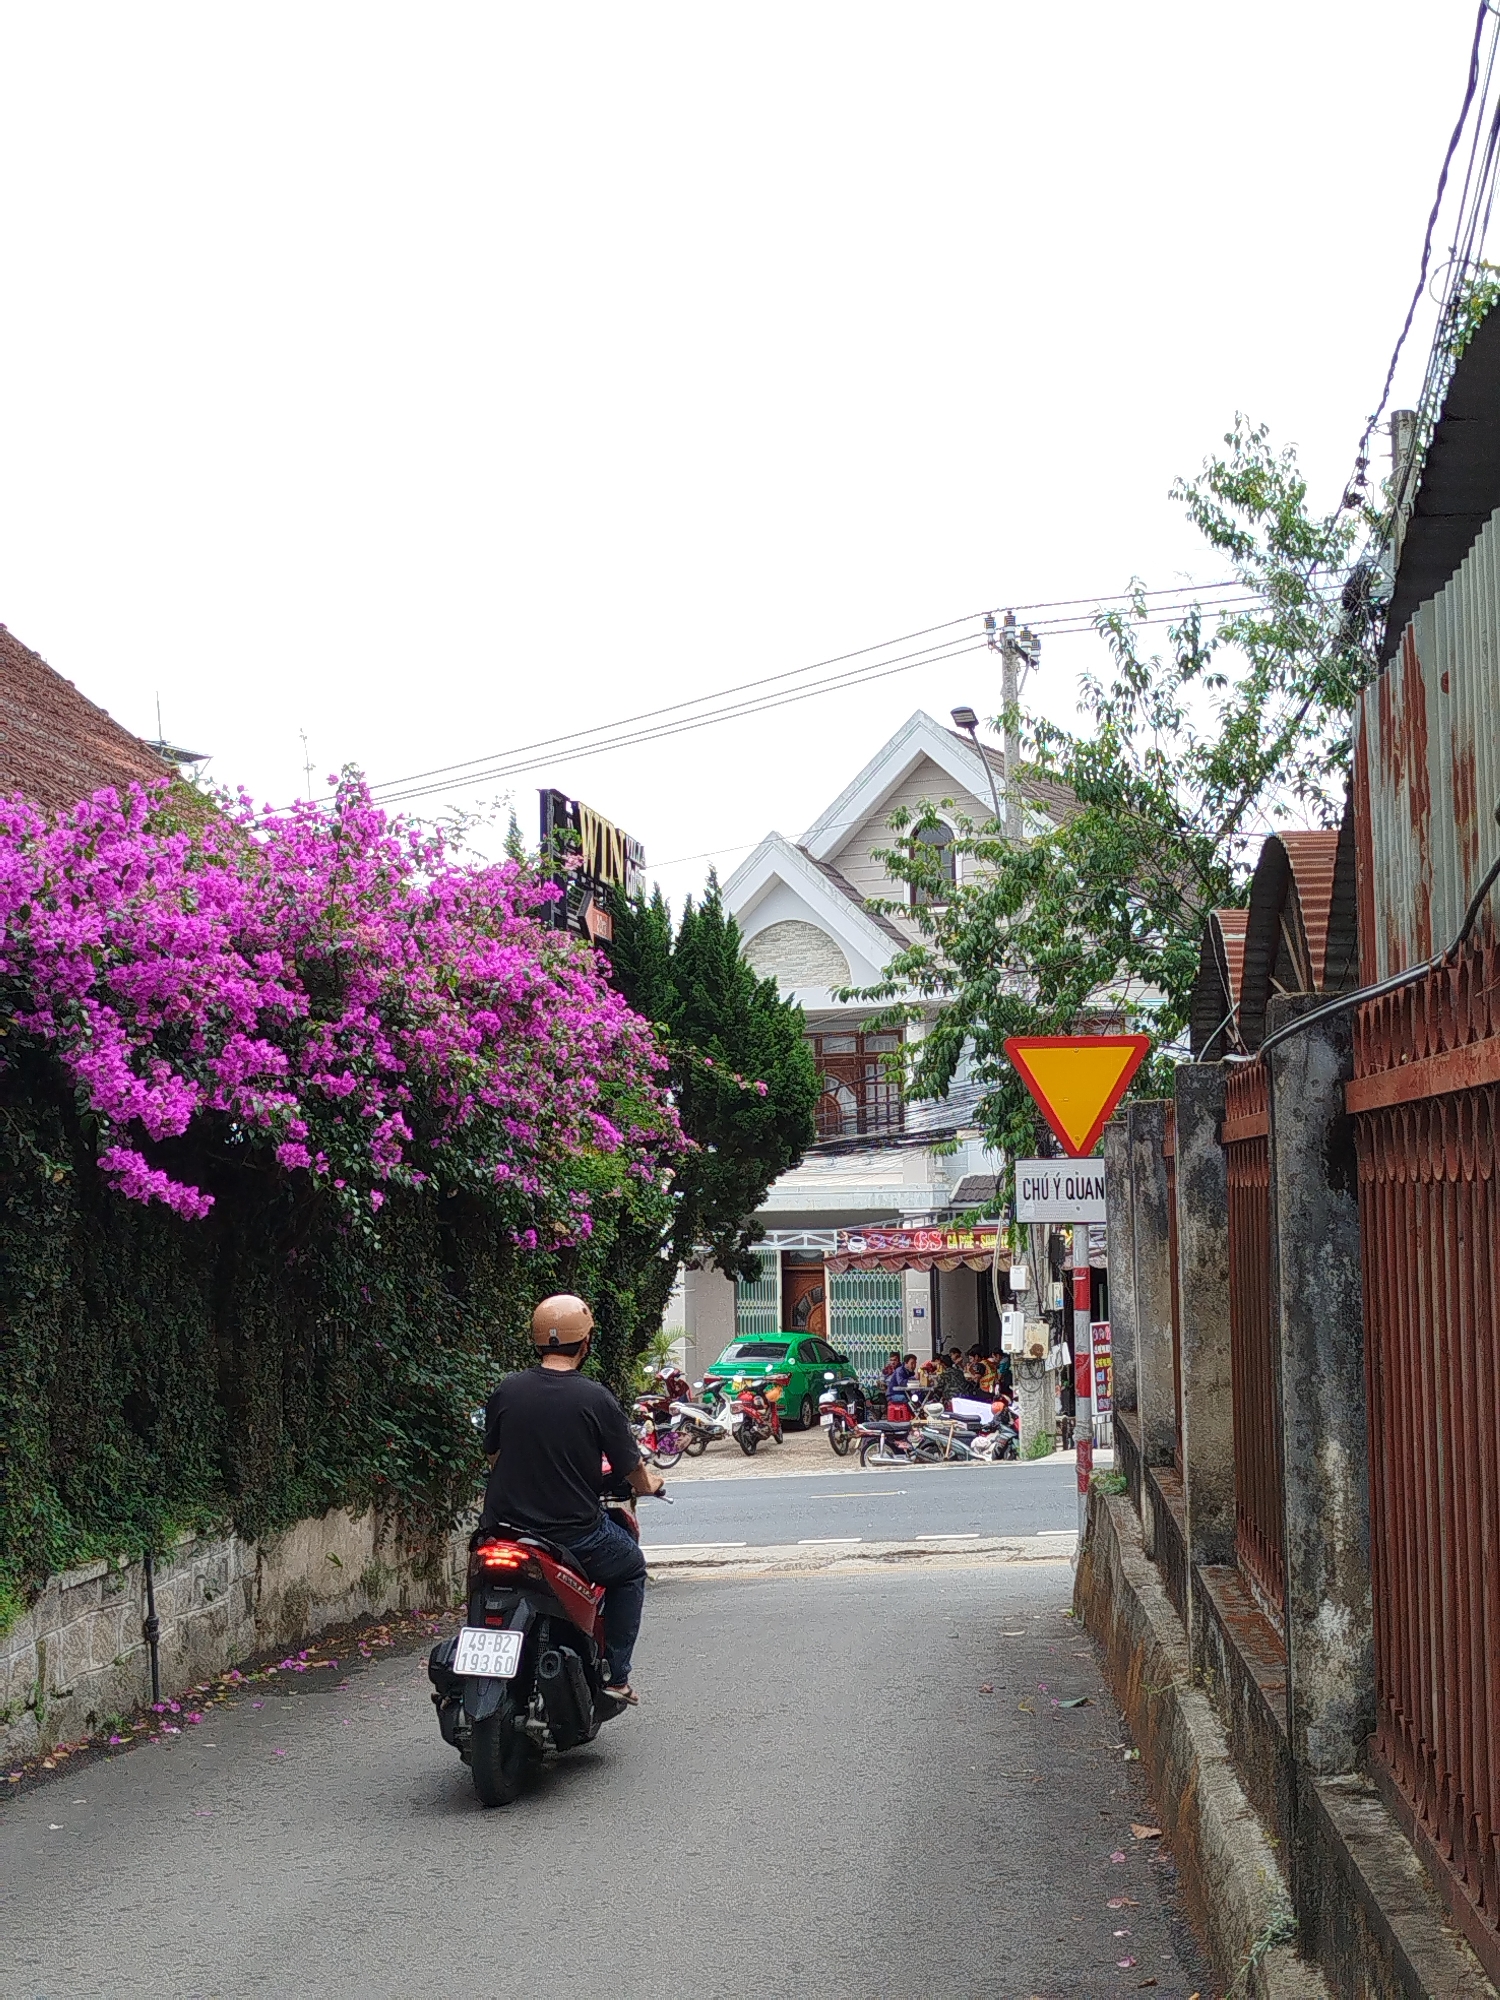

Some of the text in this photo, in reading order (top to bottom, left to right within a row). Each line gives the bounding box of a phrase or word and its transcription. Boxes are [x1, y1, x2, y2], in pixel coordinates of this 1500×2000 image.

[578, 801, 626, 886] WIN
[1023, 1172, 1105, 1200] CHÚ Ý QUAN
[468, 1632, 512, 1654] 49-B2
